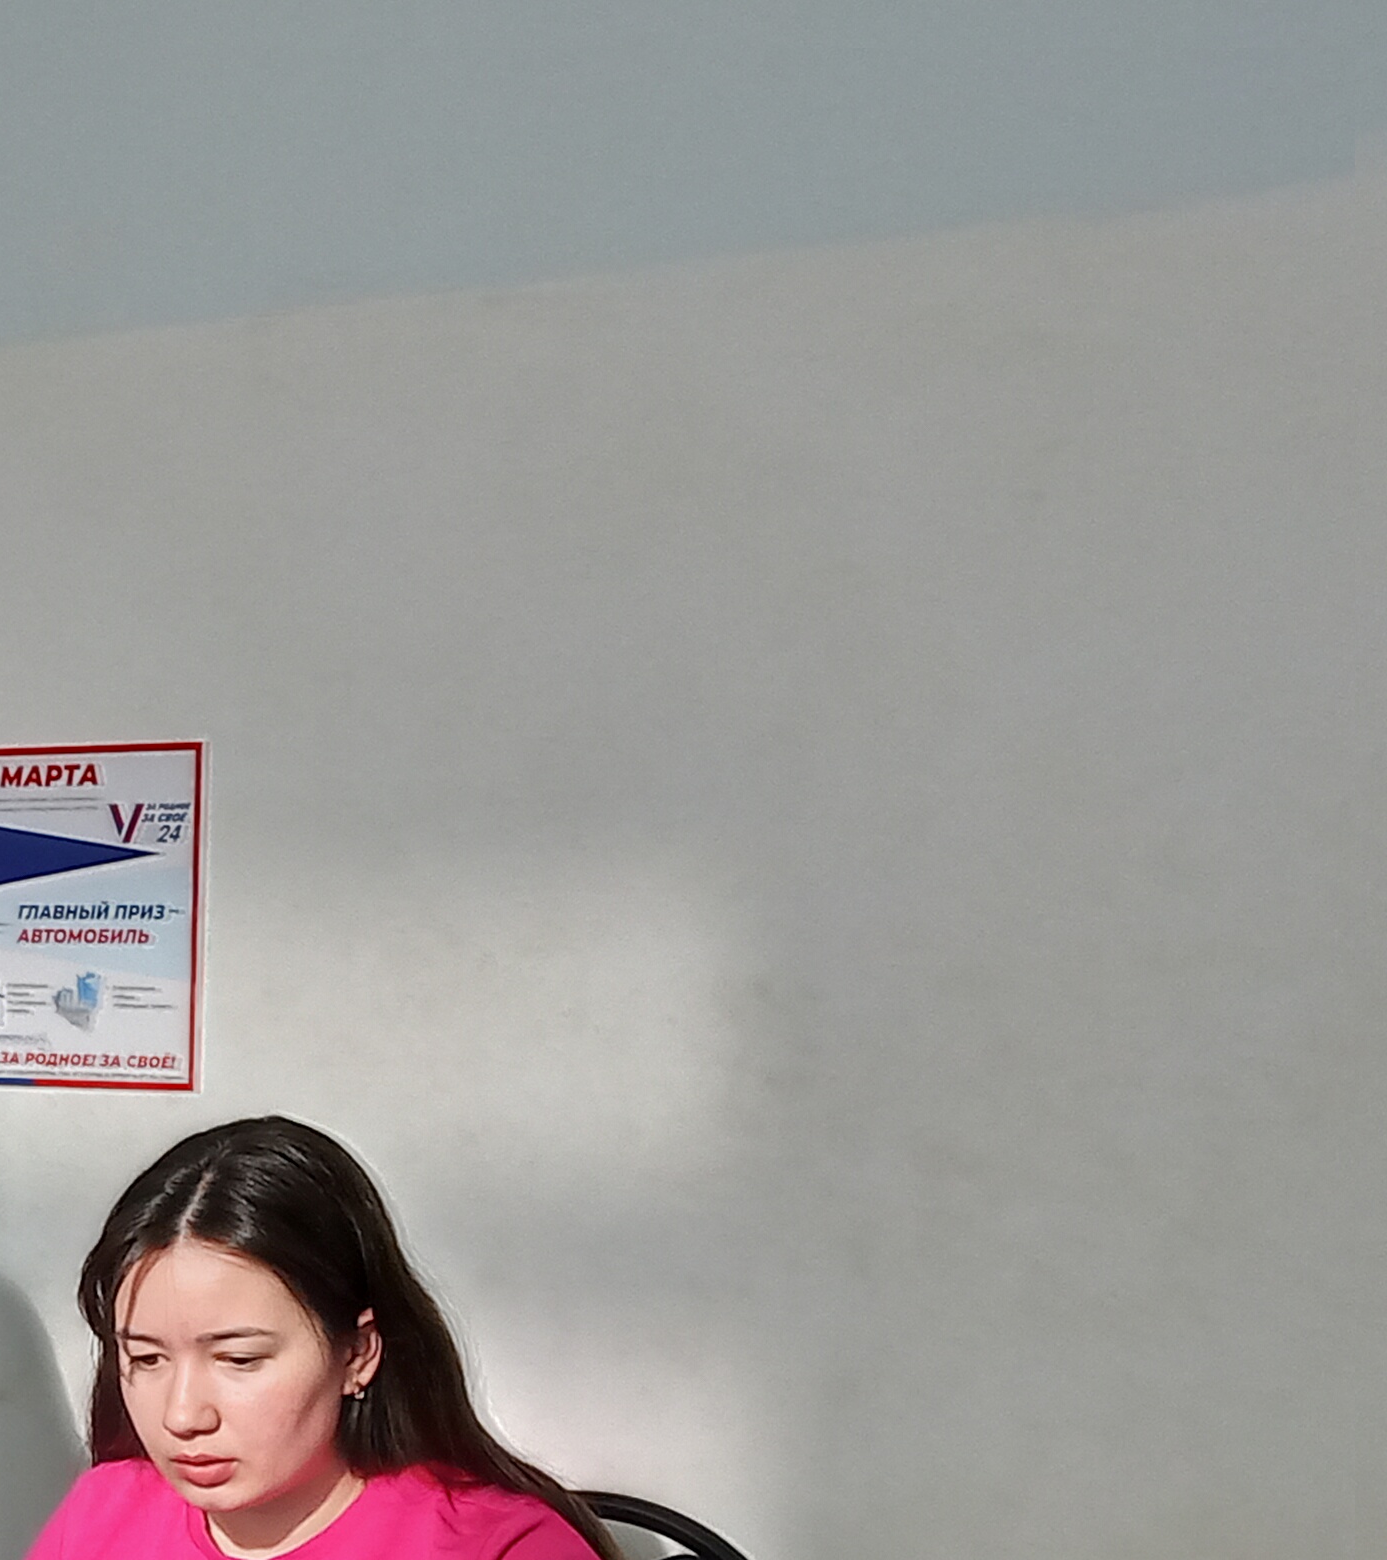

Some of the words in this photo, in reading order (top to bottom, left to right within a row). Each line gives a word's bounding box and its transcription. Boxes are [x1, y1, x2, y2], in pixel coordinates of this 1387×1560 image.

[0, 763, 100, 788] МАРТА
[155, 824, 183, 843] 24
[17, 901, 110, 921] ГЛАВНЫЙ
[113, 904, 166, 920] ПРИЗ
[16, 928, 151, 945] АВТОМОБИЛЬ
[25, 1051, 97, 1069] РОДНОЕ!
[100, 1053, 122, 1068] ЗА
[126, 1052, 177, 1070] СВОЁ!
